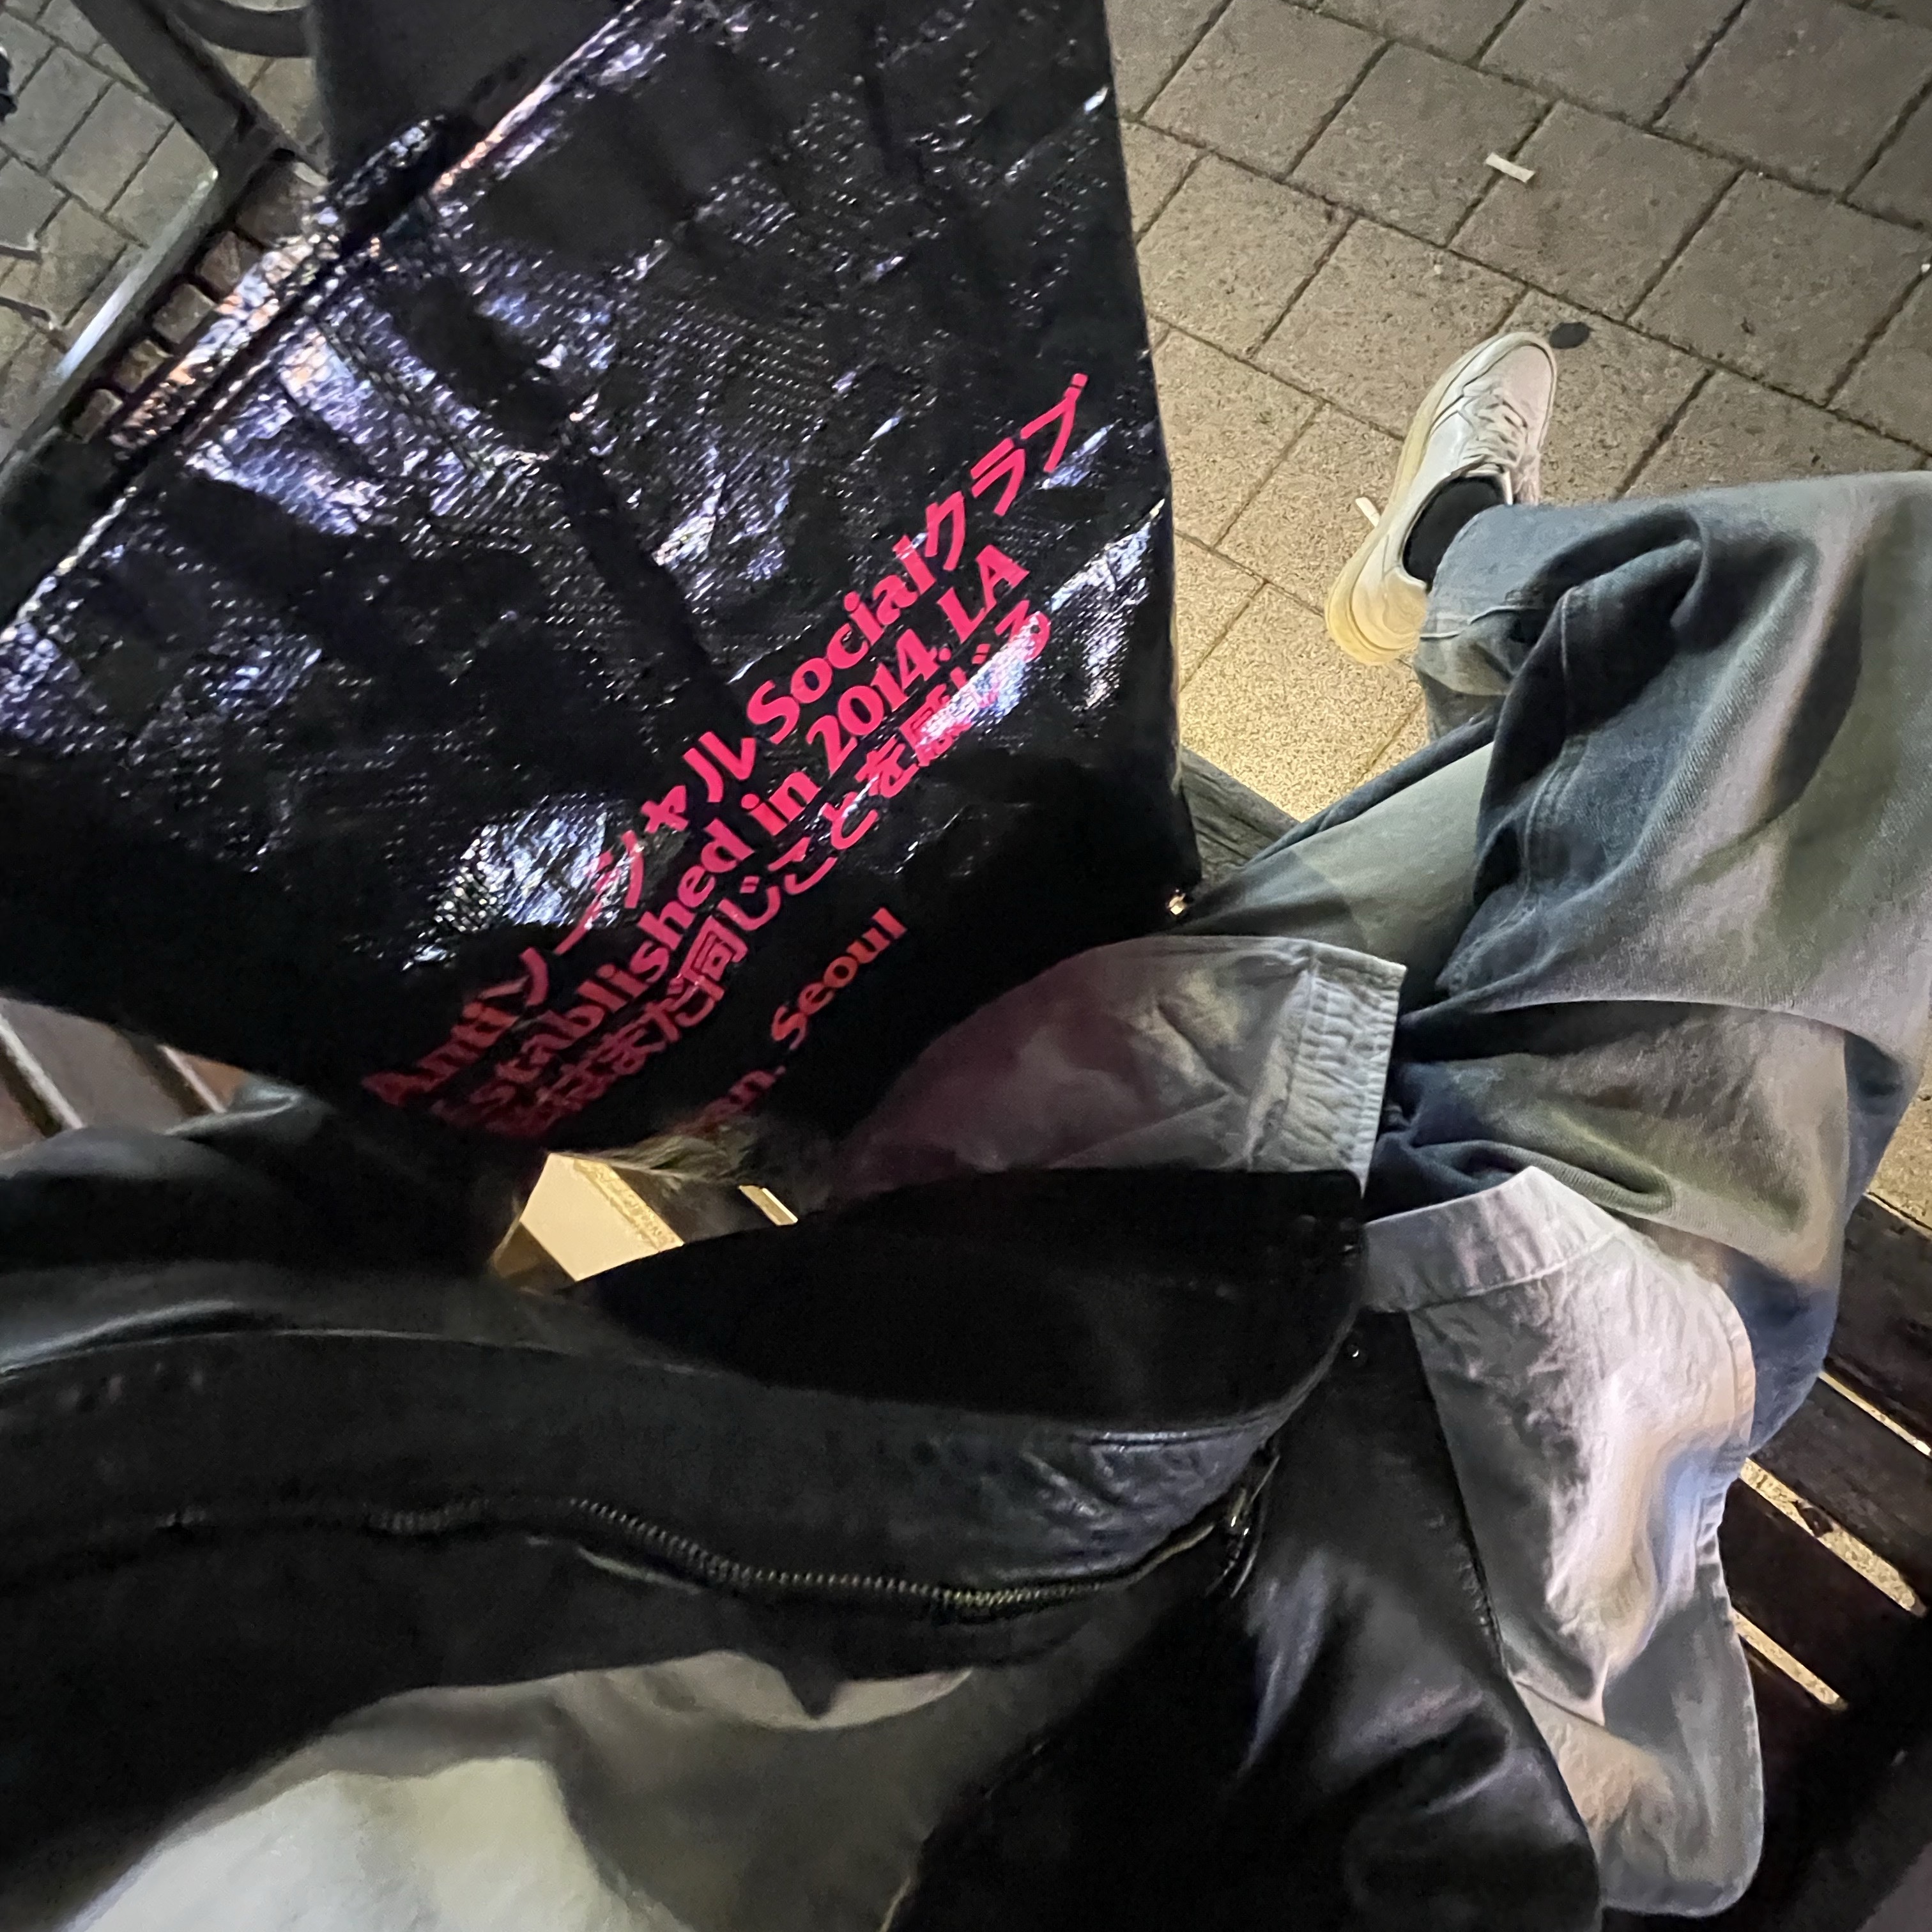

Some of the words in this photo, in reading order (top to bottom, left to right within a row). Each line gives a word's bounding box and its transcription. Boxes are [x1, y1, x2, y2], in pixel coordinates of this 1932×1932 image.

[741, 770, 822, 835] in
[807, 629, 952, 776] 2014.
[937, 544, 1030, 643] LA
[772, 907, 907, 1051] Seoul
